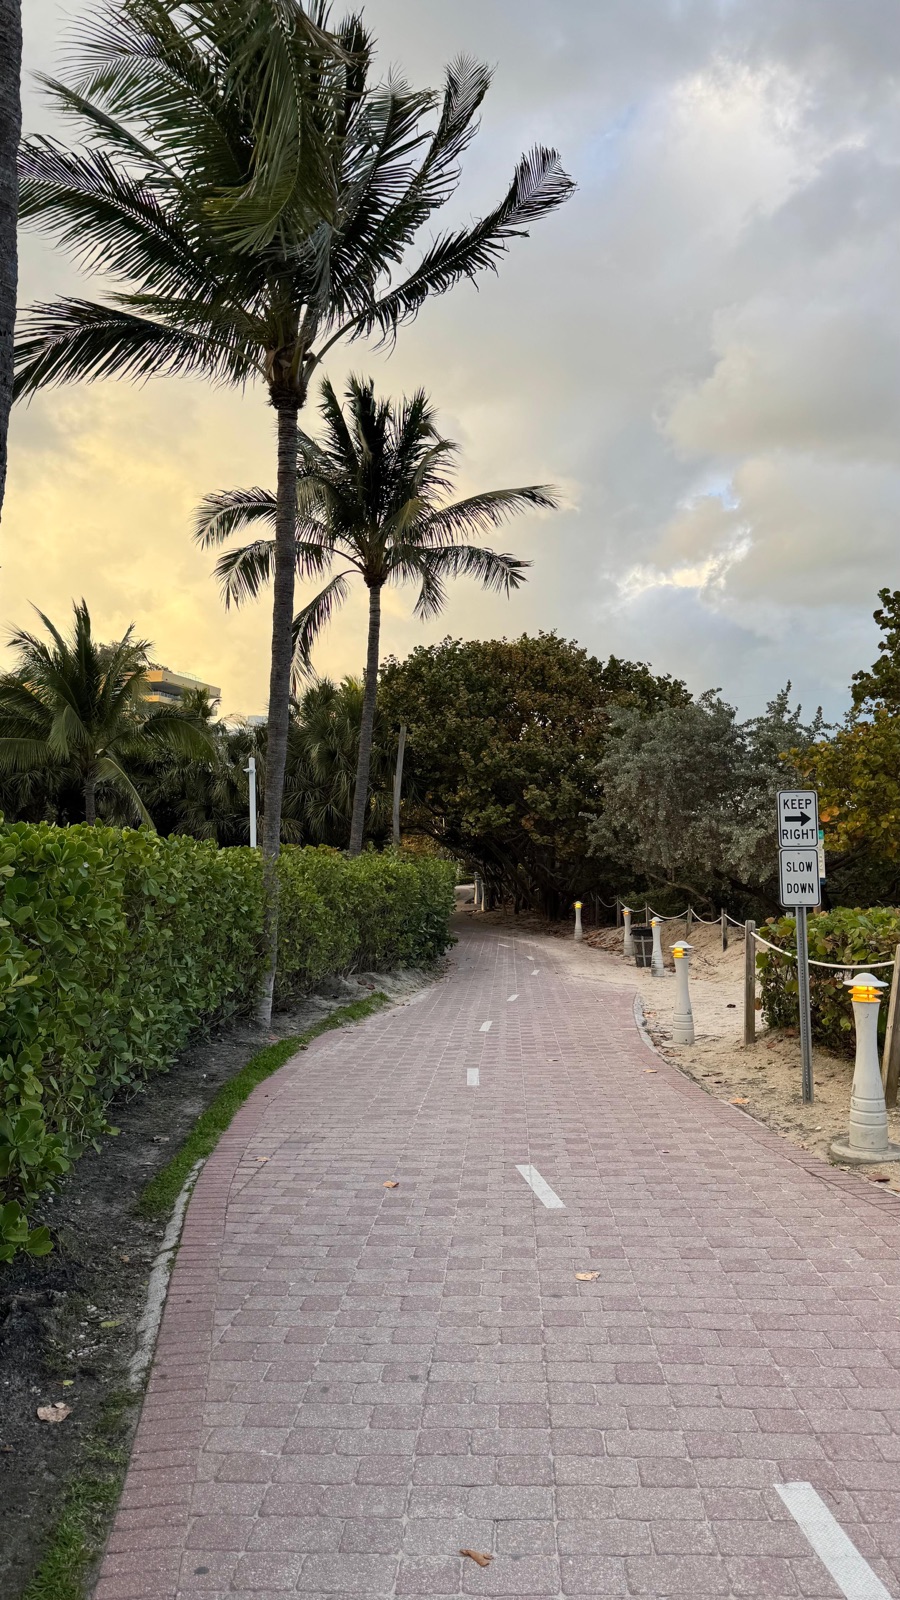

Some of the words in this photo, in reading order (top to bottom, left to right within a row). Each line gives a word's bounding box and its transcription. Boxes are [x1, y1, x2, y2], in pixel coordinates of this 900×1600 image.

[783, 799, 812, 810] KEEP
[782, 829, 815, 839] RIGHT
[786, 862, 813, 872] SLOW
[787, 883, 814, 893] DOWN
